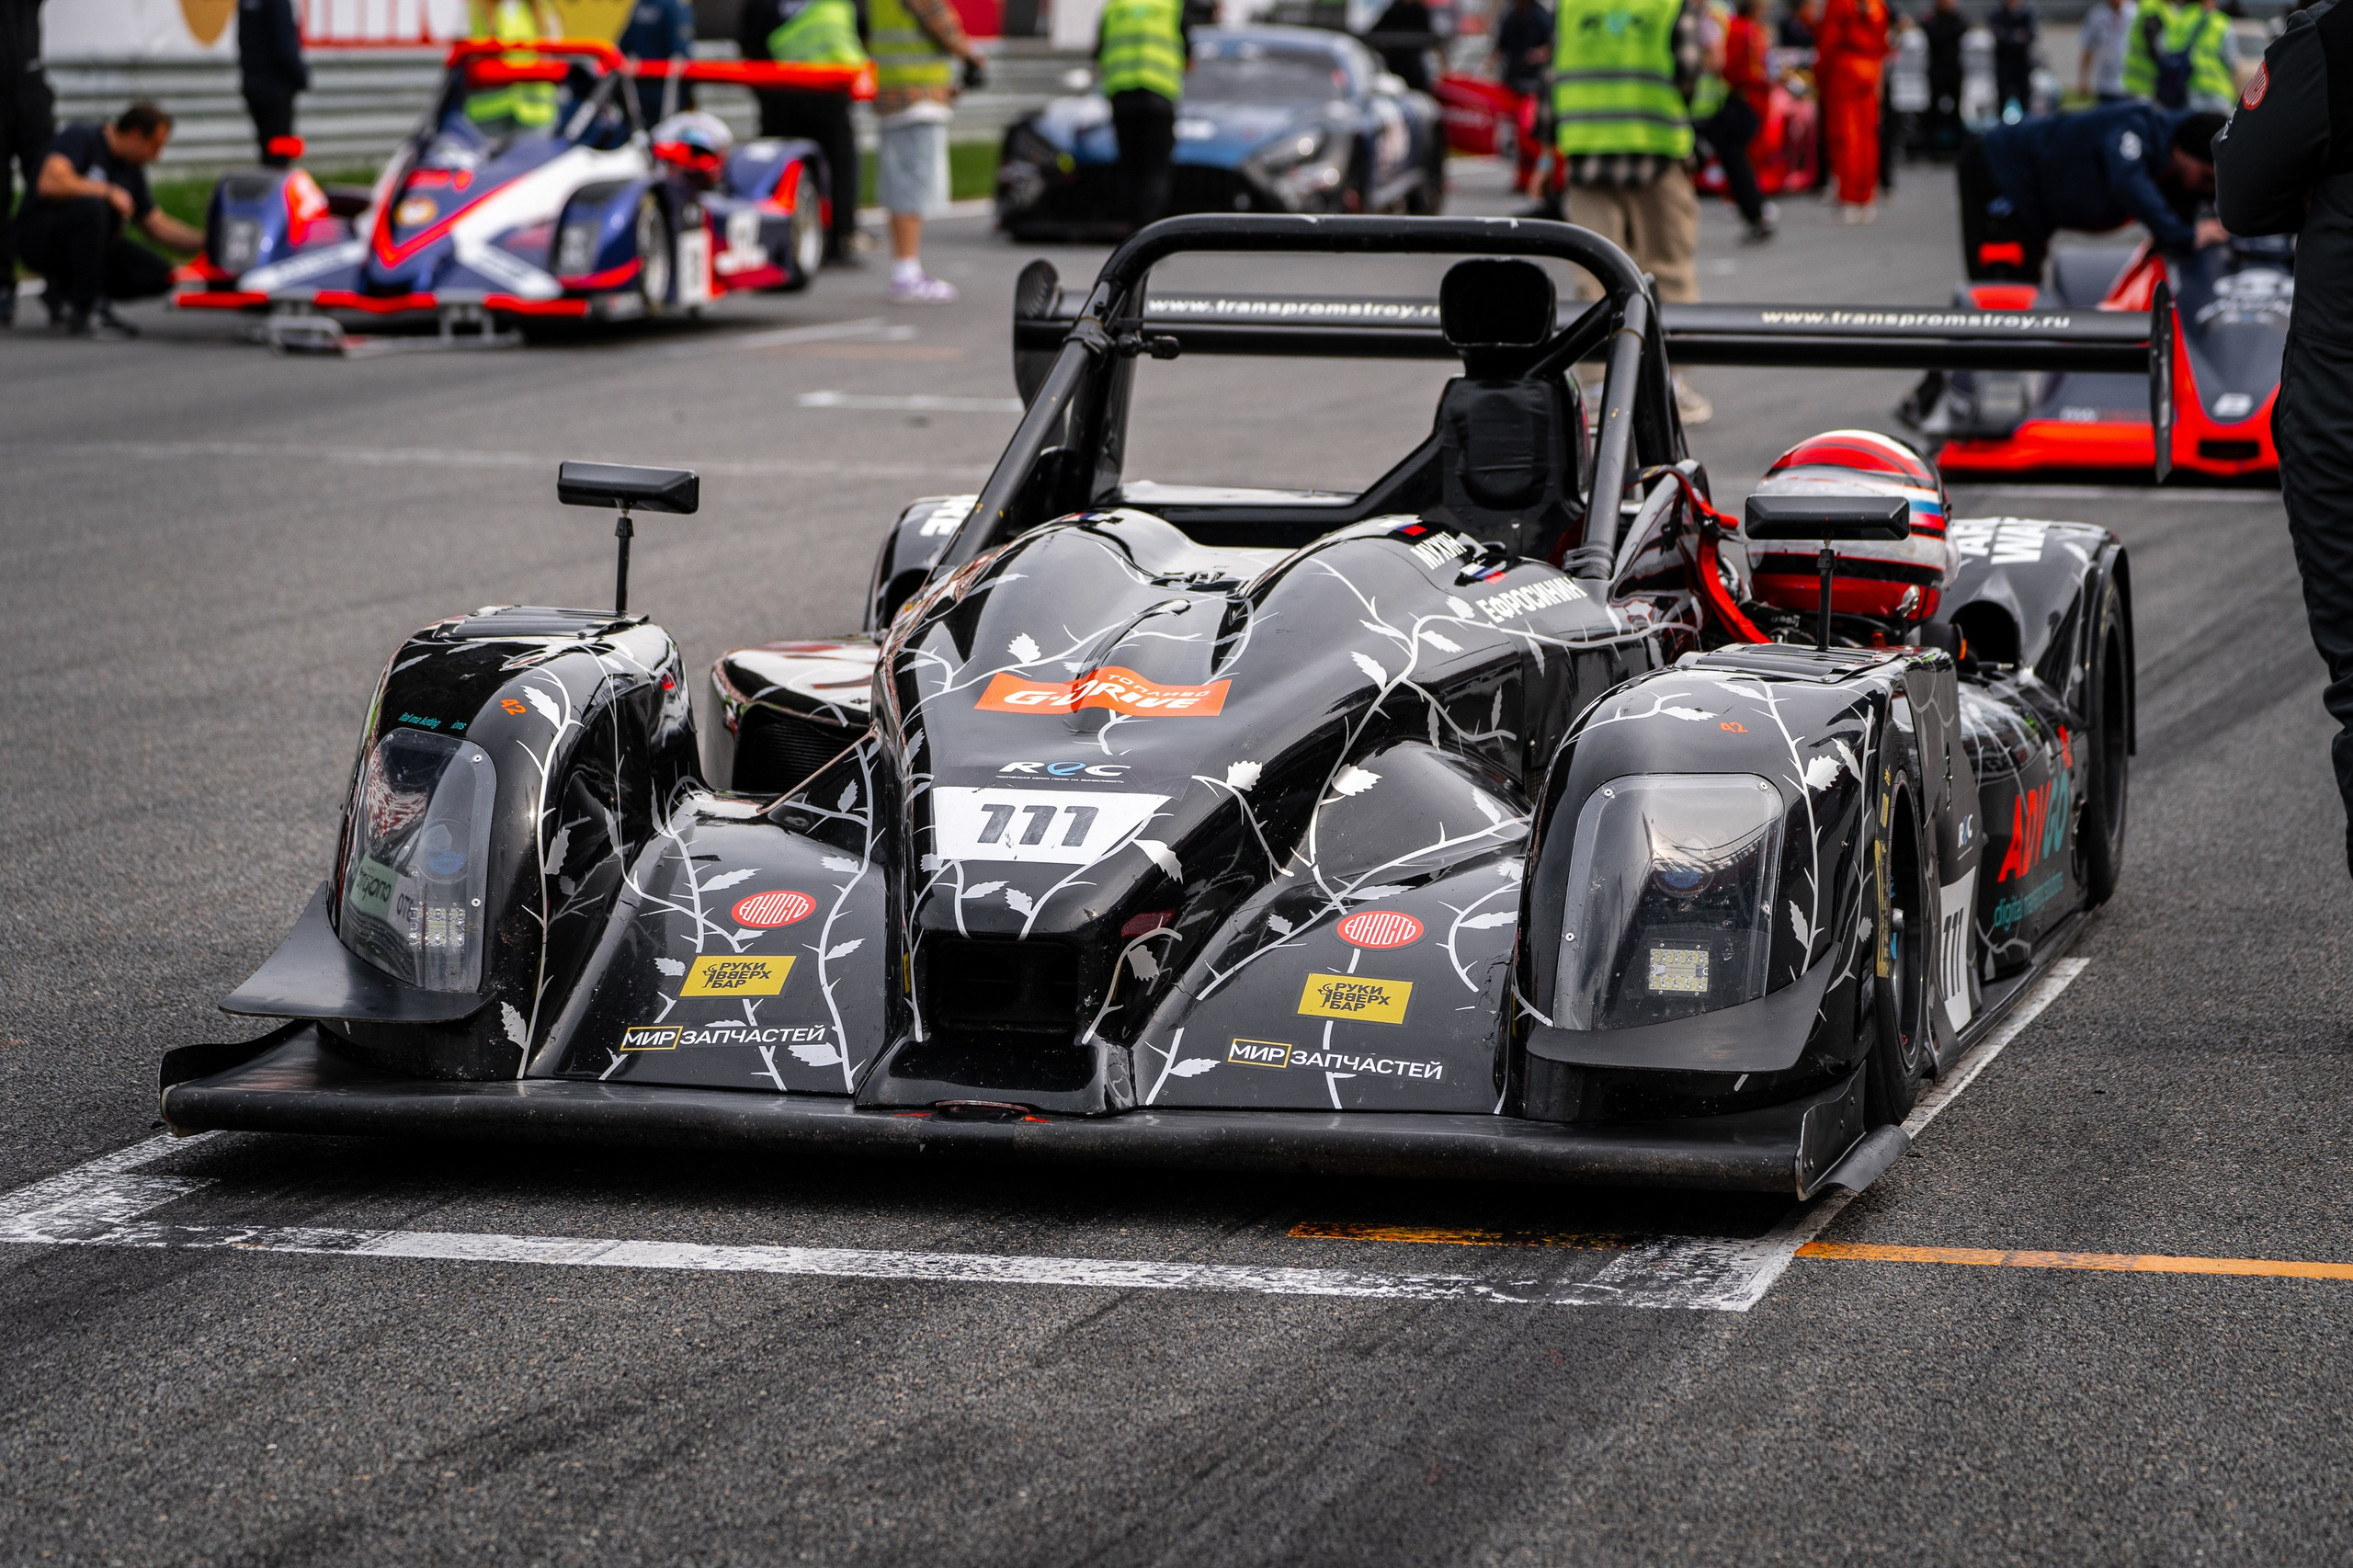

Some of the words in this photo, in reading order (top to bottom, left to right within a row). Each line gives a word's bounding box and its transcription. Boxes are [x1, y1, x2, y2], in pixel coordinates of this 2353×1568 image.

[1761, 311, 2071, 330] www.transpromstroy.ru
[1409, 531, 1467, 570] МУХИН
[1475, 576, 1587, 623] ЕФРОСИНИН
[977, 804, 1099, 846] 111
[719, 962, 767, 971] РУКИ
[710, 980, 746, 989] БАР
[1335, 983, 1383, 995] РУКИ
[1329, 1001, 1366, 1012] БАР
[622, 1030, 676, 1046] МИР
[679, 1025, 825, 1045] ЗАПЧАСТЕЙ
[1229, 1043, 1285, 1062] МИР
[1290, 1051, 1443, 1080] ЗАПЧАСТЕЙ
